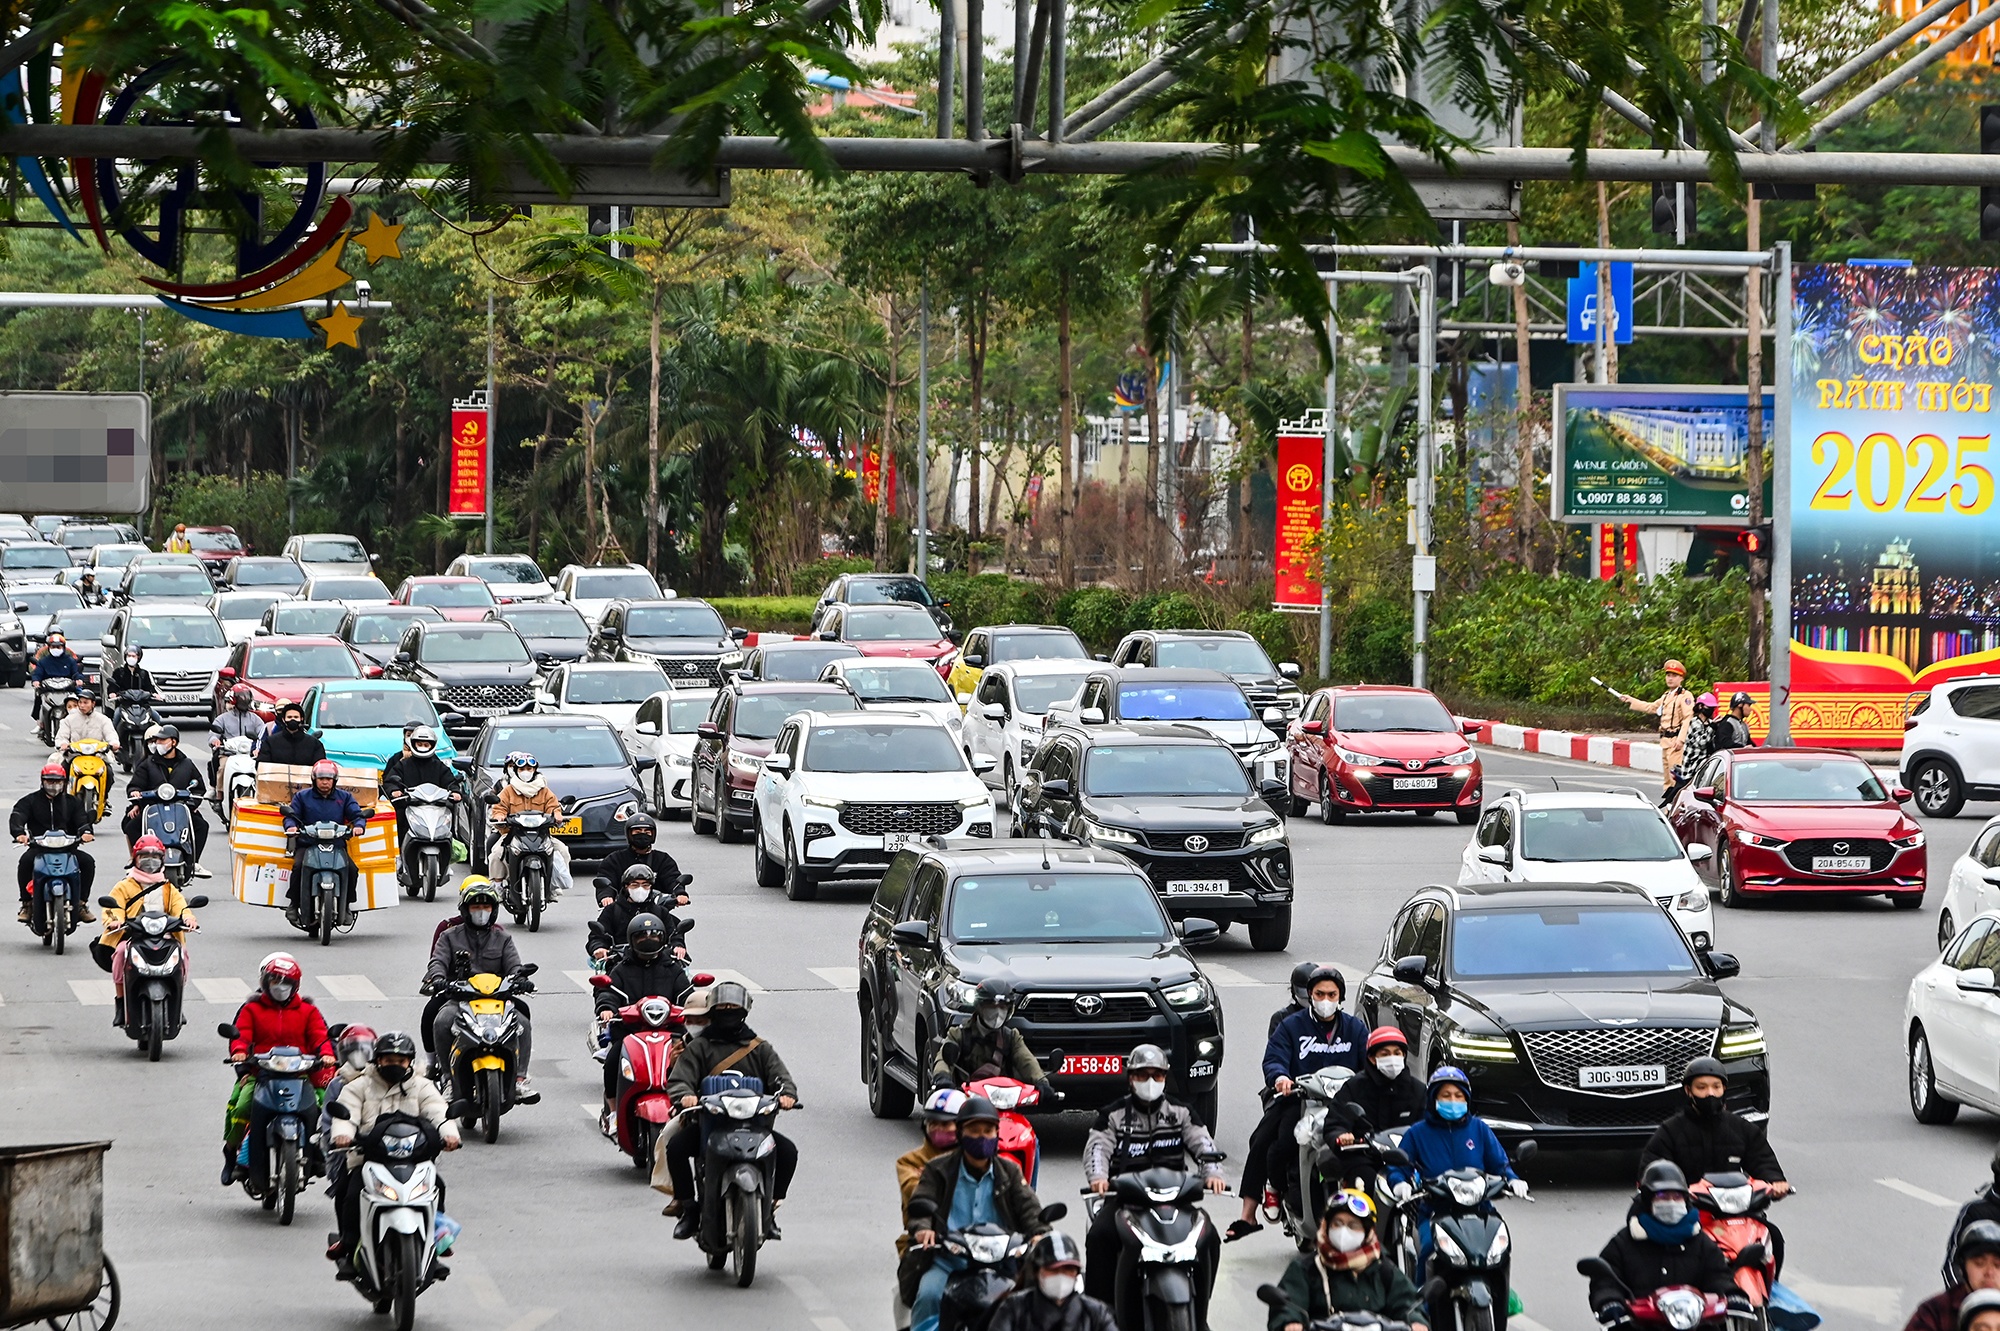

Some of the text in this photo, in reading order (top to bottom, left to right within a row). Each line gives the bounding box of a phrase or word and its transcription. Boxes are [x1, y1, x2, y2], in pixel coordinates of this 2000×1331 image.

[1858, 329, 1953, 371] CHÀO
[1816, 373, 1994, 413] NĂM MỚI
[1573, 459, 1608, 470] AVENUE
[1809, 430, 1995, 516] 2025
[1587, 492, 1663, 505] 0907 88 36 36
[895, 834, 910, 843] 30K
[1817, 859, 1866, 868] 20A-854.67
[1172, 882, 1223, 893] 30L-394.81
[1587, 1069, 1659, 1083] 30G-905.89
